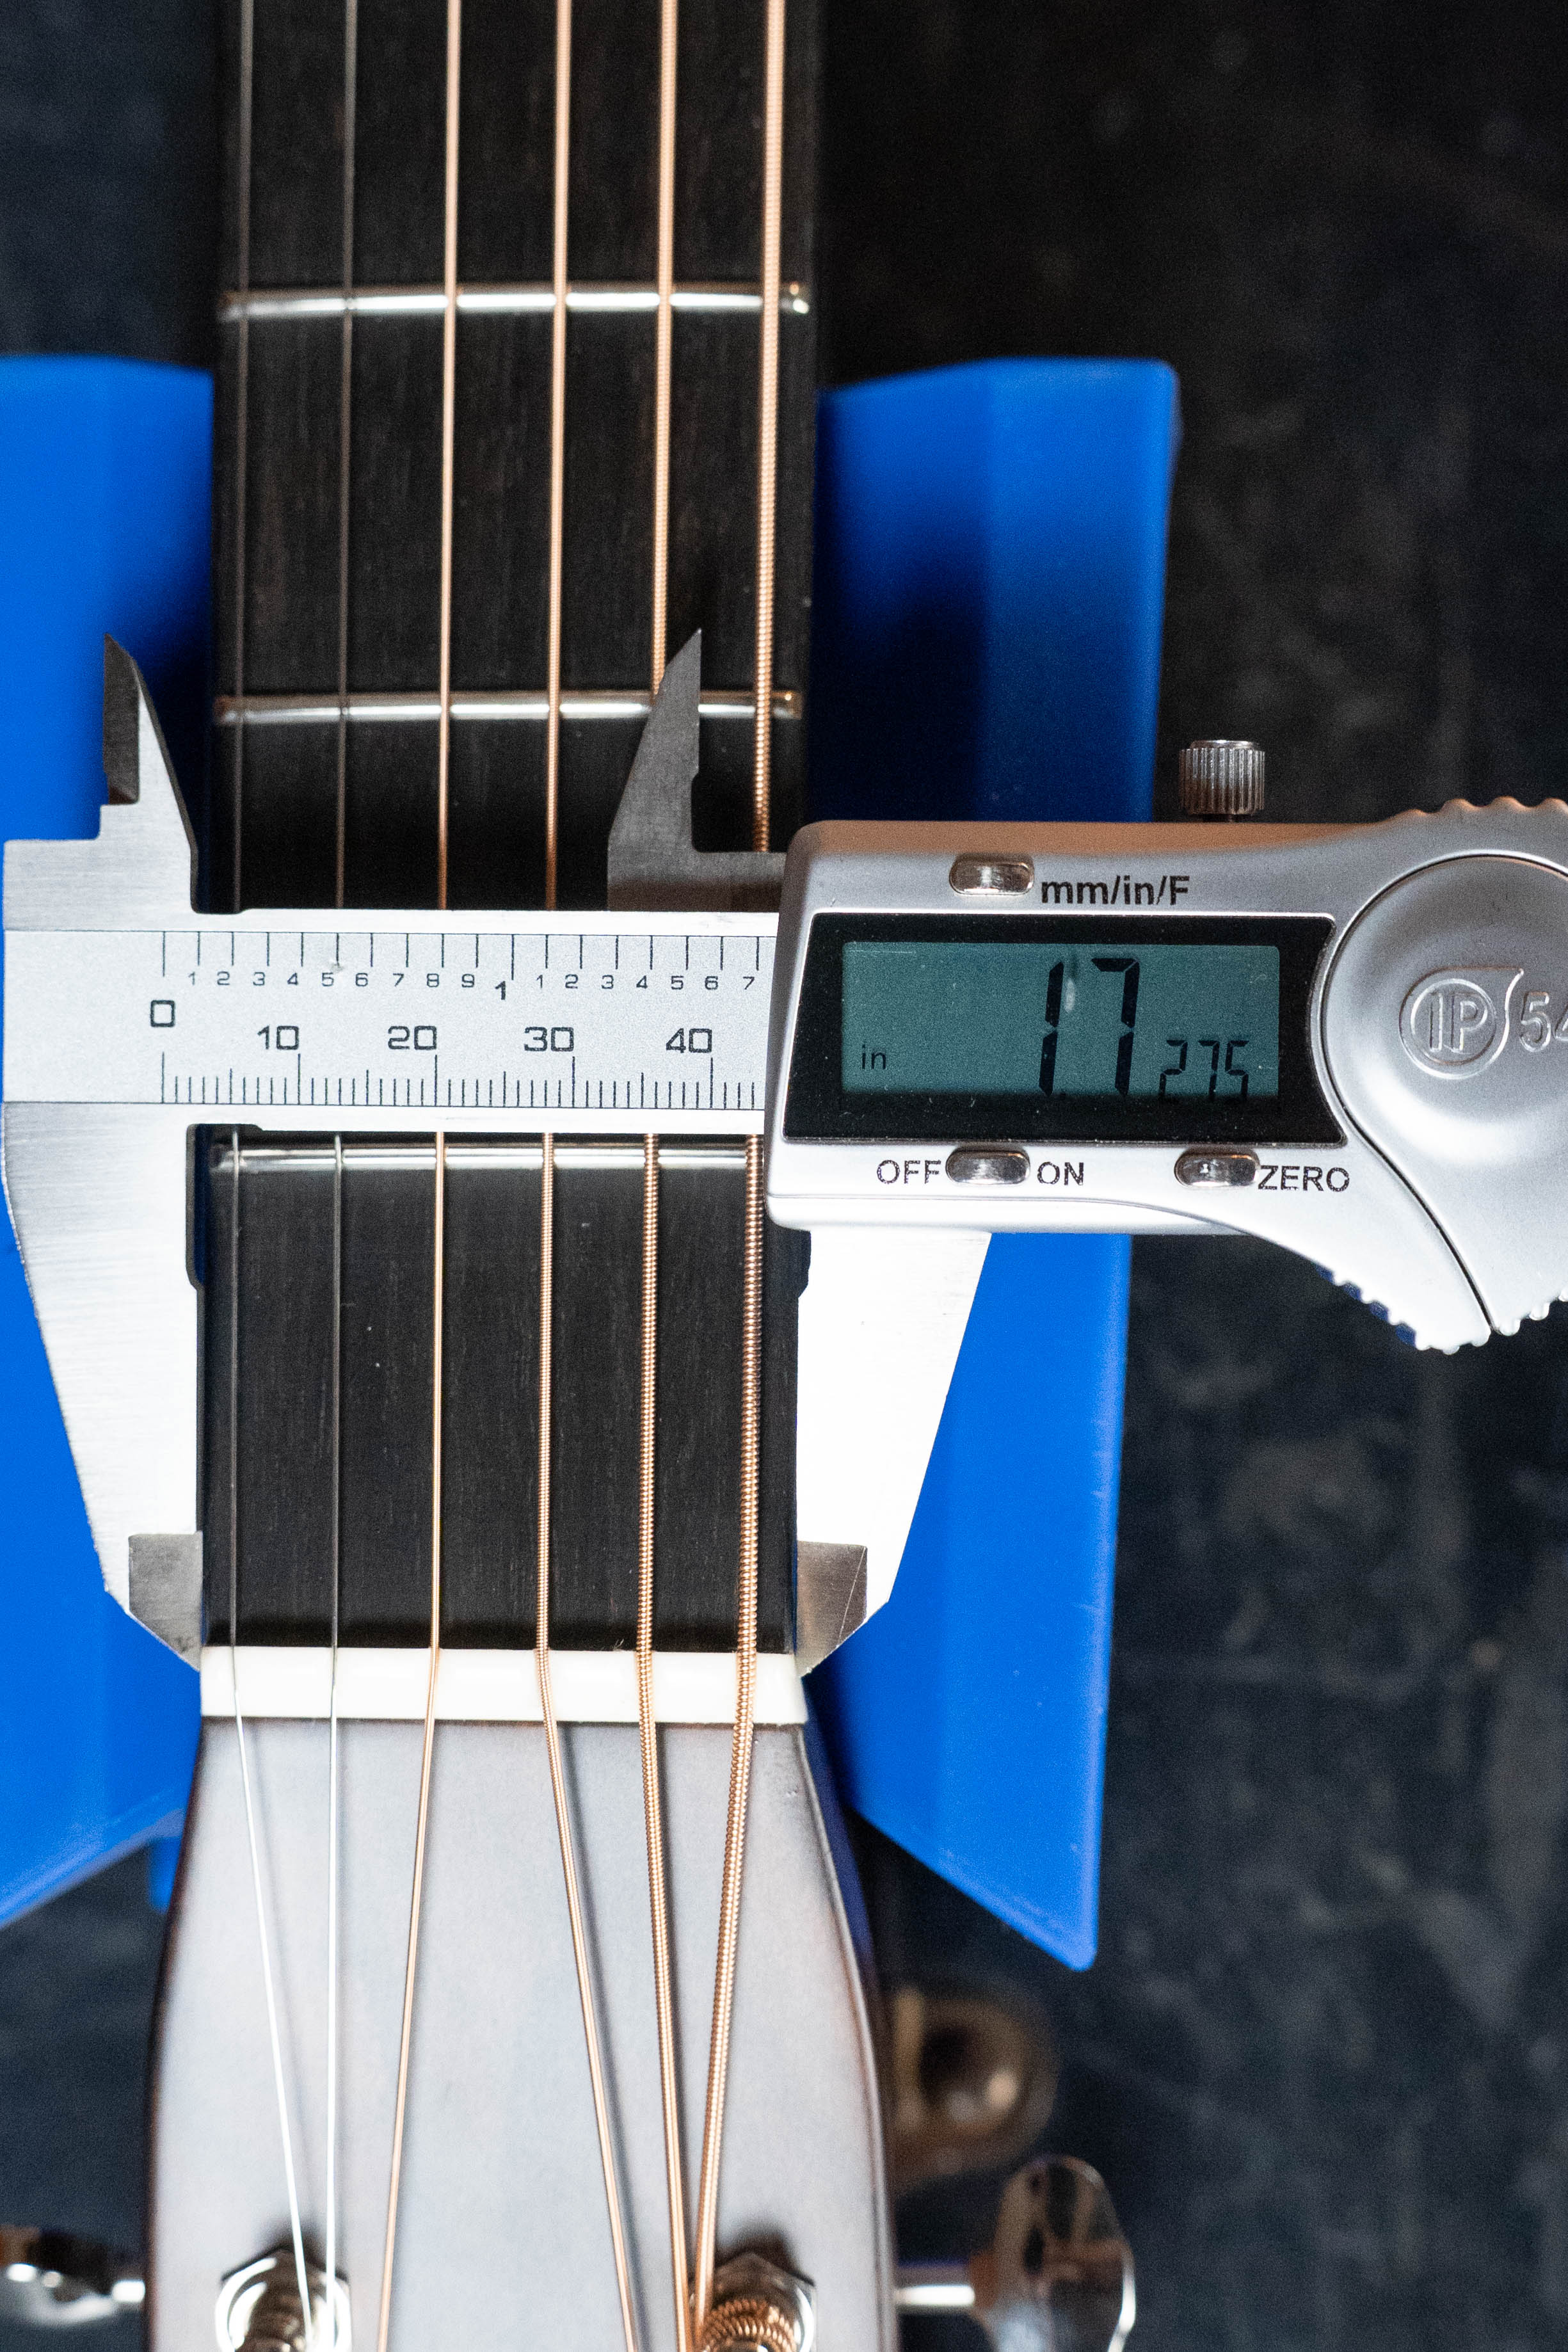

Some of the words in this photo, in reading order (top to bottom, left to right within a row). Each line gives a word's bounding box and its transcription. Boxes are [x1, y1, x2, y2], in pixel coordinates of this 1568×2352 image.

[1041, 875, 1190, 906] mm/in/F
[188, 971, 196, 986] 1
[216, 970, 230, 986] 2
[252, 971, 266, 987] 3
[287, 972, 299, 986] 4
[321, 972, 335, 988] 5
[355, 972, 369, 988] 6
[392, 973, 404, 987] 7
[426, 973, 440, 988] 8
[461, 973, 476, 988] 9
[495, 980, 506, 1000] 1
[536, 974, 543, 989] 1
[564, 973, 579, 989] 2
[601, 974, 614, 990] 3
[636, 975, 648, 989] 4
[671, 975, 684, 991] 5
[704, 975, 719, 991] 6
[742, 976, 755, 991] 7
[149, 999, 176, 1028] 0
[257, 1025, 300, 1051] 10
[387, 1025, 437, 1051] 20
[524, 1026, 575, 1052] 30
[666, 1028, 713, 1054] 40
[1429, 992, 1489, 1055] IP
[861, 1044, 887, 1071] in
[876, 1159, 942, 1185] OFF
[1037, 1161, 1085, 1186] ON
[1258, 1165, 1350, 1192] ZERO
